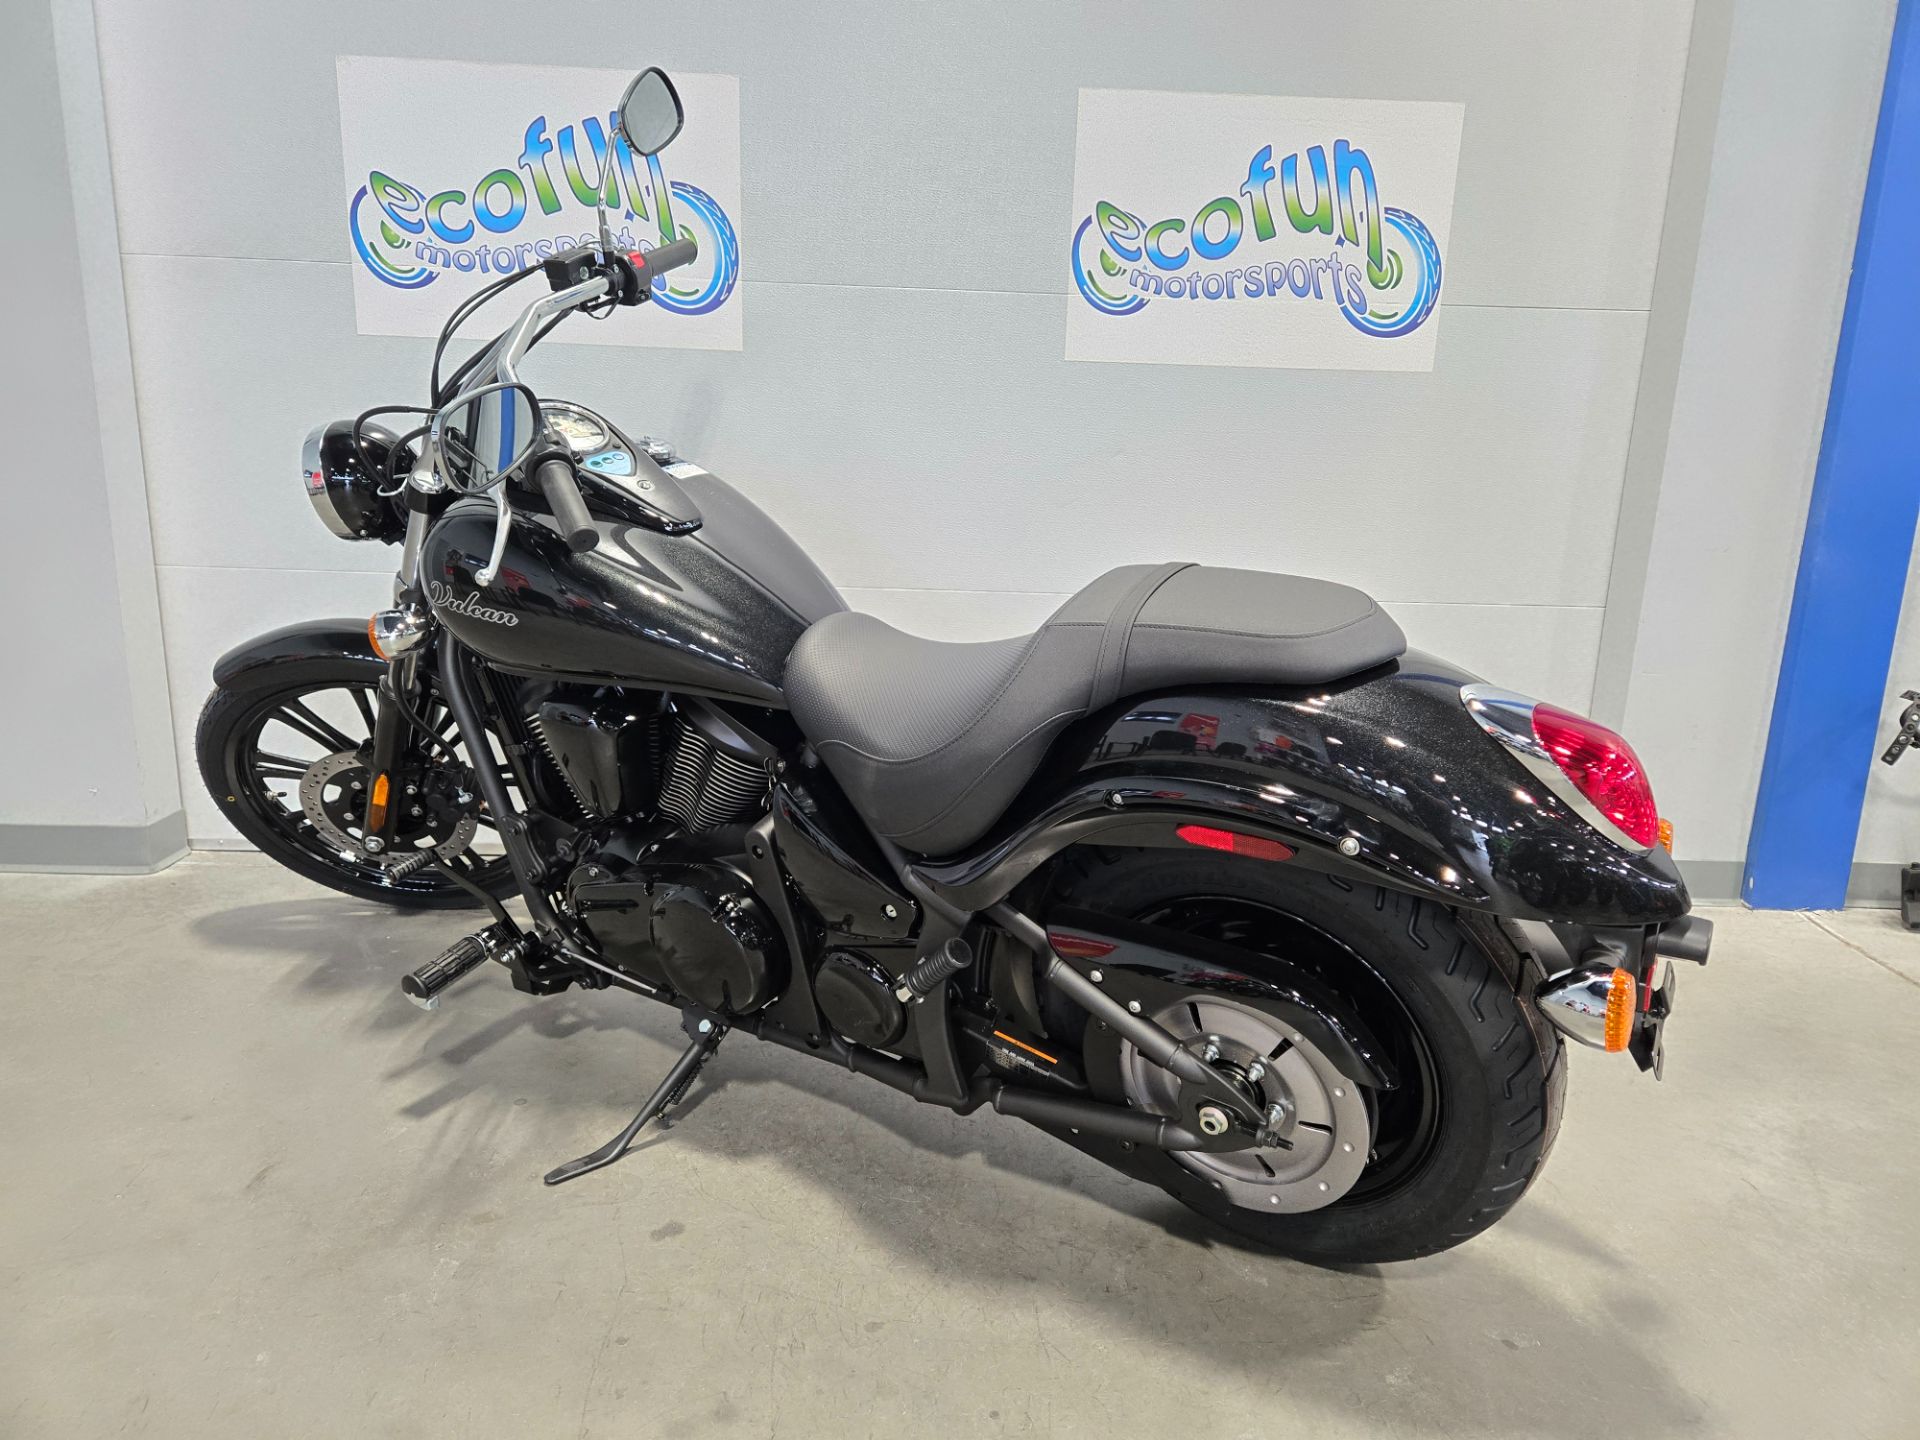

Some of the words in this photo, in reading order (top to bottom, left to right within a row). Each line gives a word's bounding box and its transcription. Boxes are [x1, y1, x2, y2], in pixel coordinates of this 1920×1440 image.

[414, 226, 667, 292] motorst
[1129, 251, 1367, 315] motorsports
[430, 580, 519, 627] Vulcan
